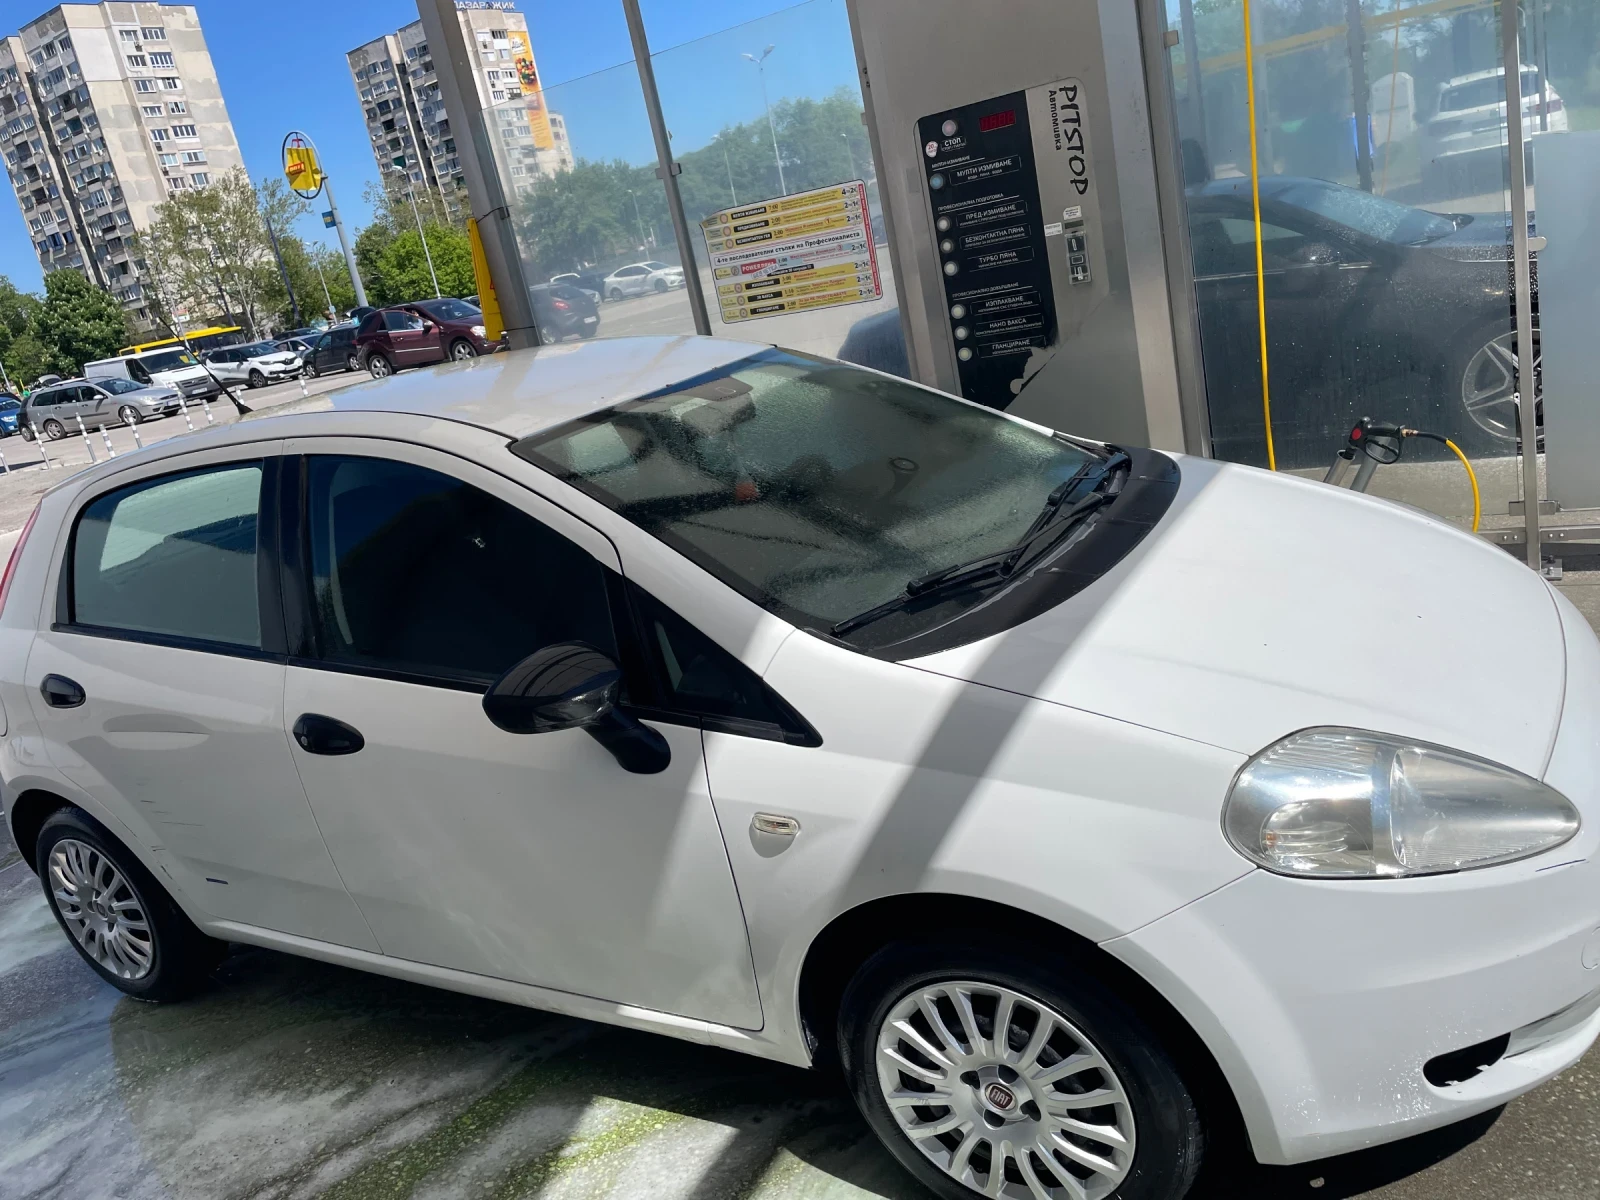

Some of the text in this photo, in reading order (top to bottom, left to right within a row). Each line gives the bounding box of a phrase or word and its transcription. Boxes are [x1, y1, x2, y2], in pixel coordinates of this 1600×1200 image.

[1049, 90, 1061, 150] Автомивка
[944, 138, 961, 147] СТОП
[1059, 85, 1088, 195] PITSTOP
[956, 159, 1012, 177] МУЛТИ ИЗМИВАНЕ
[965, 204, 1016, 220] ПРЕД-ИЗМИВАНЕ
[775, 245, 795, 253] стъпки
[804, 232, 860, 246] Професионалиста
[965, 230, 1008, 243] БЕЗКОНТАКТНА
[1008, 226, 1025, 234] ПЯНА
[979, 254, 998, 263] ТУРБО
[999, 251, 1017, 260] ПЯНА
[985, 296, 1024, 307] ИЗПЛАКВАНЕ
[989, 318, 1027, 329] НАНО ВАКСА
[992, 339, 1031, 350] ГЛАНЦИРАНЕ
[990, 1088, 1010, 1106] FIAT
